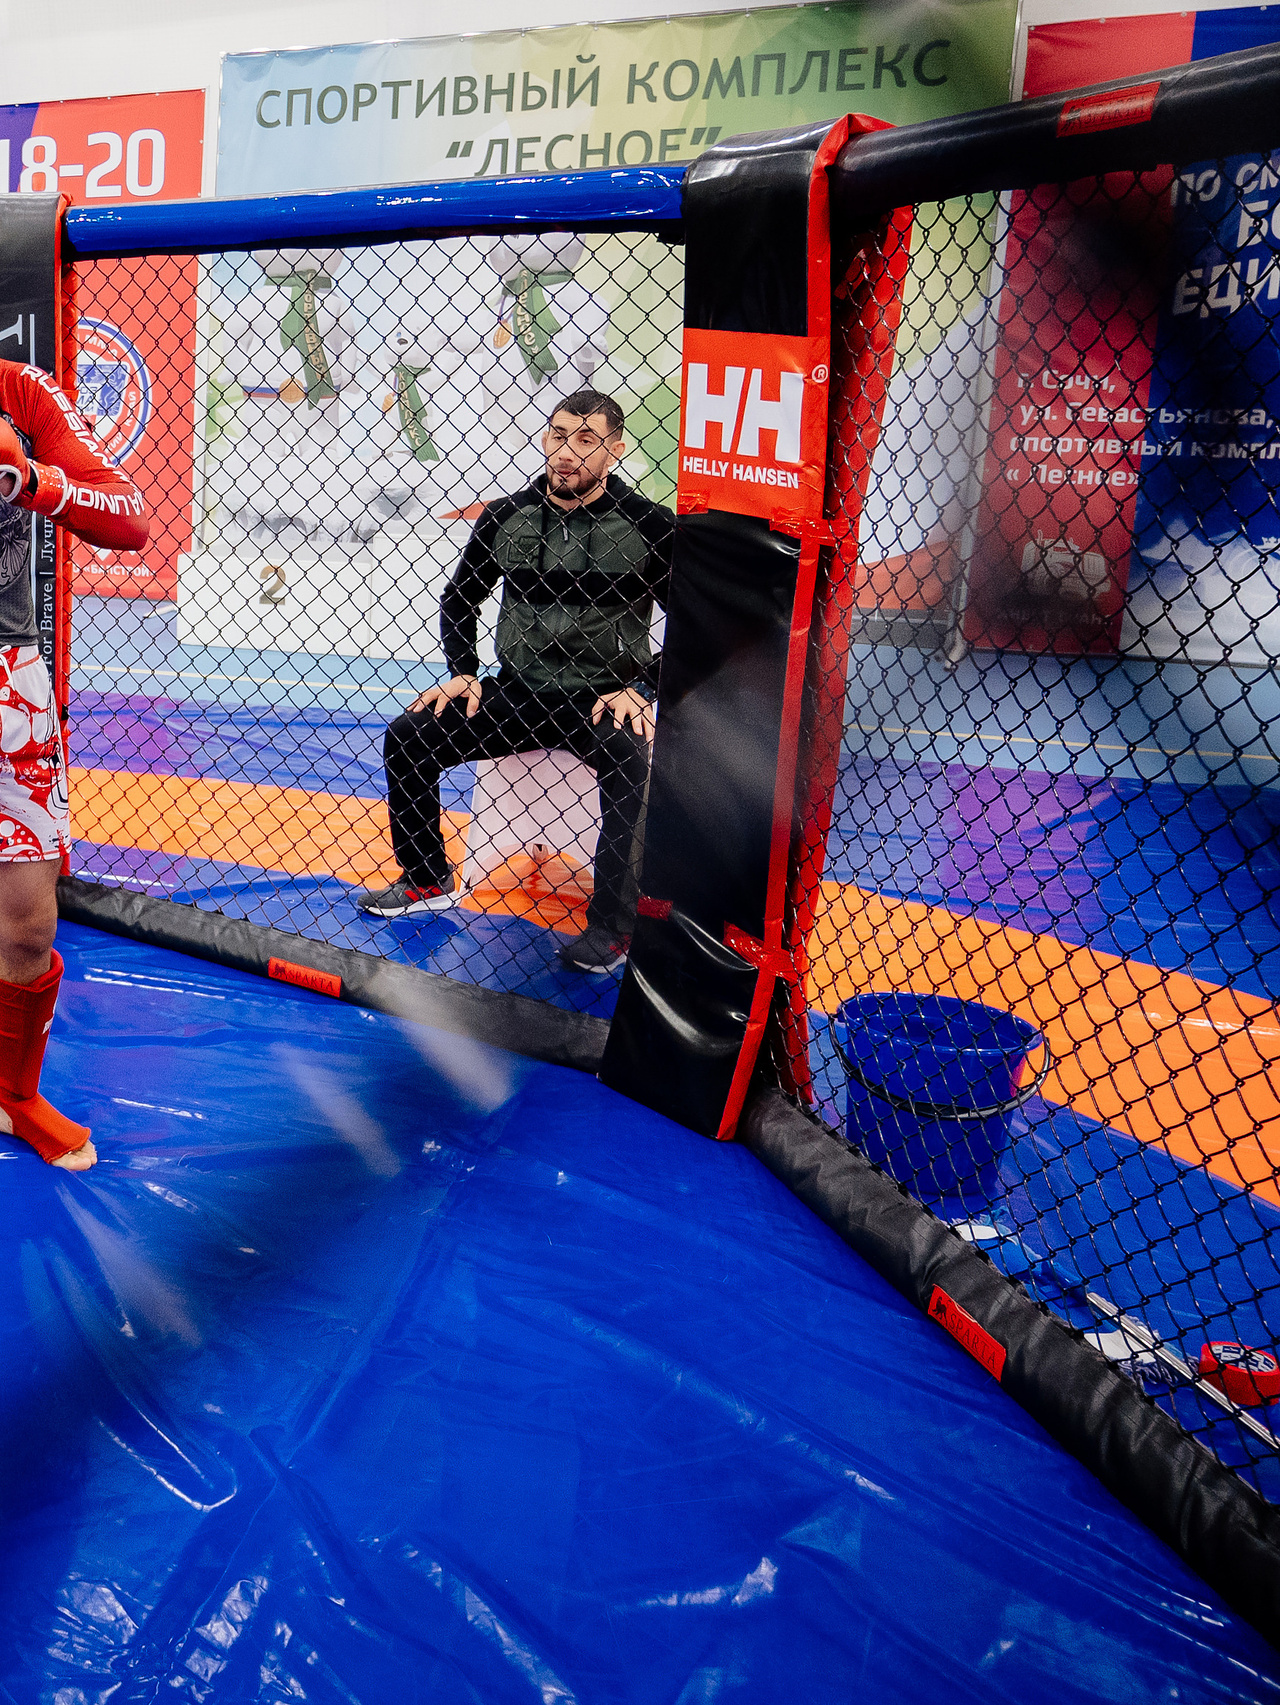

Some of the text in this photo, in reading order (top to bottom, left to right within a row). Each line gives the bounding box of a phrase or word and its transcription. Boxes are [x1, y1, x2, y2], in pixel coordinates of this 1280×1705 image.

[255, 39, 952, 129] СПОРТИВНЫЙ КОМПЛЕКС
[1171, 169, 1221, 206] ПО
[1042, 369, 1116, 393] Сочи,
[20, 364, 116, 468] RUSSIAN
[682, 456, 799, 489] HELLY HANSEN
[40, 583, 53, 631] Brave
[259, 565, 286, 606] 2
[948, 1313, 997, 1369] SPARTA
